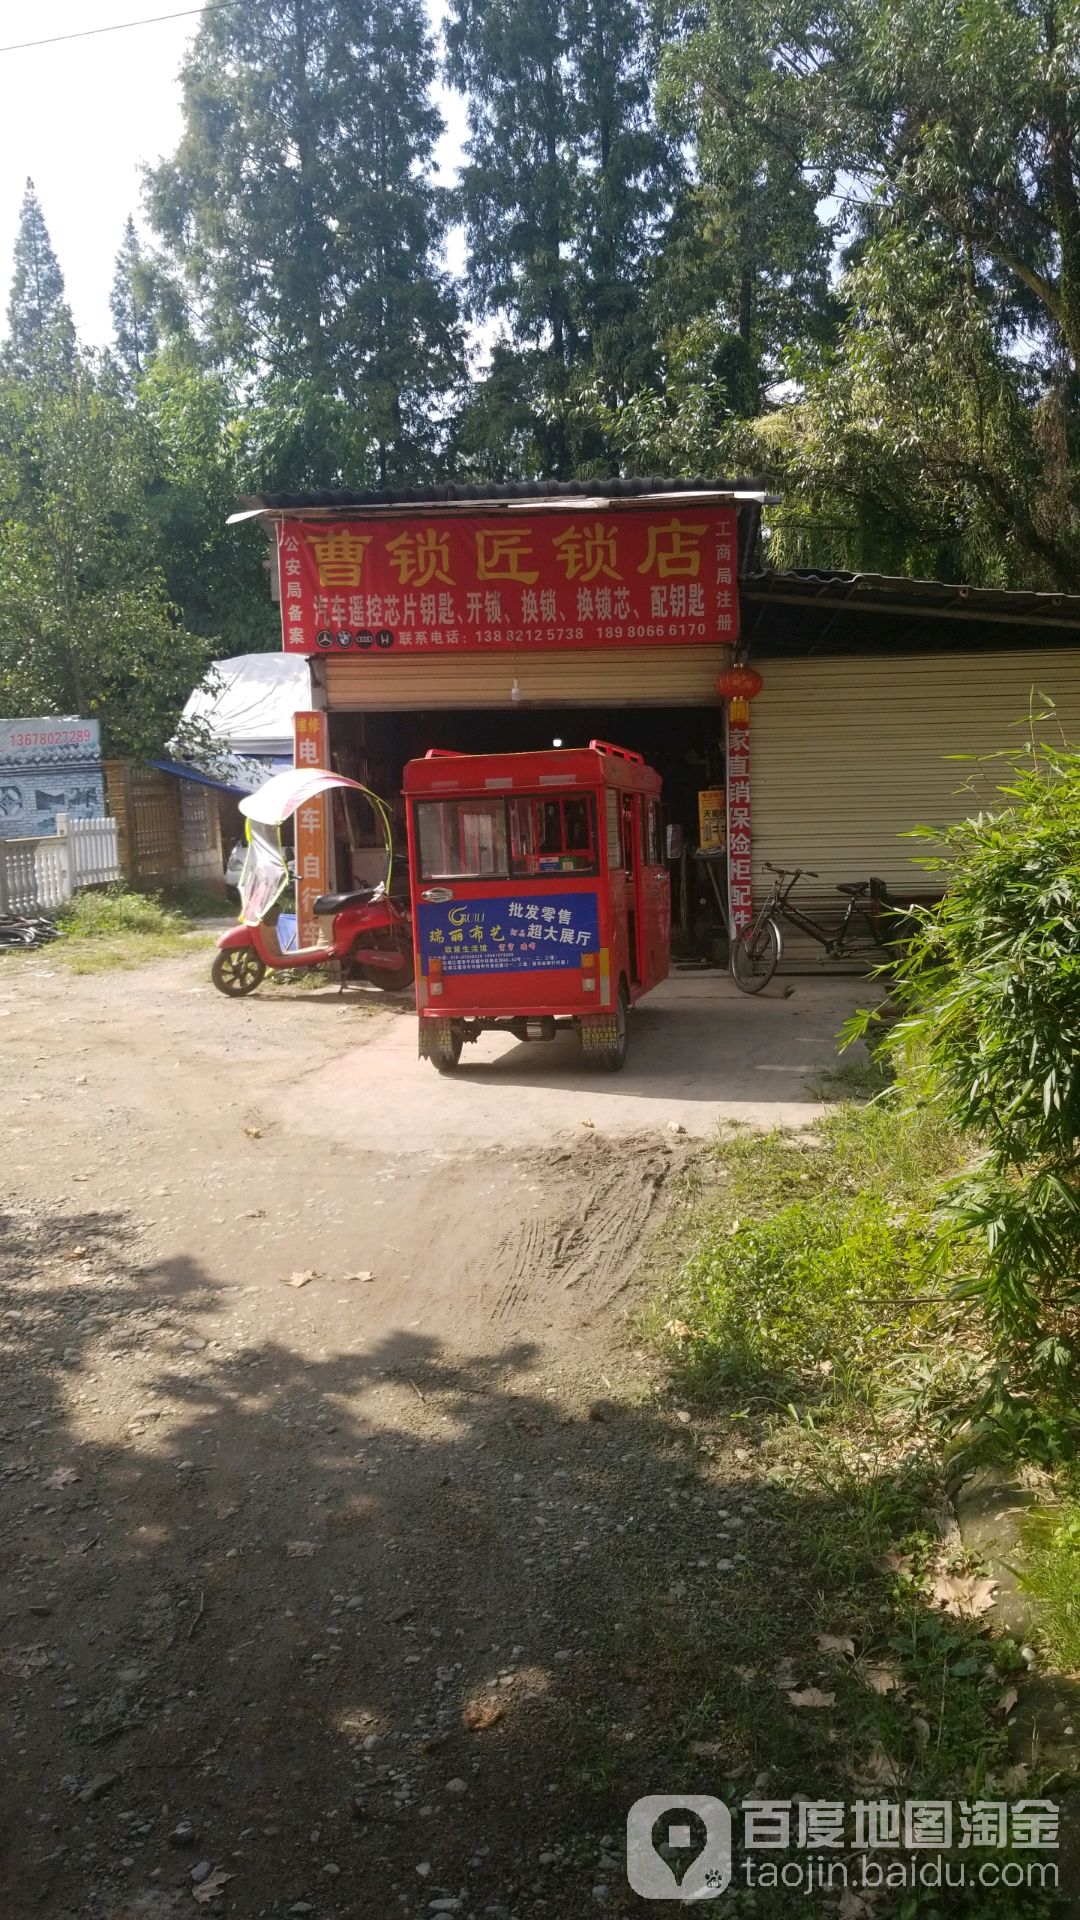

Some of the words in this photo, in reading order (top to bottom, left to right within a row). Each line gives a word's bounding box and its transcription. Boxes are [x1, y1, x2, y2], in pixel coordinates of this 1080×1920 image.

[306, 518, 709, 587] 曹锁匠锁店
[716, 521, 732, 631] 工商局注册
[285, 535, 304, 645] 公安局备案
[296, 717, 320, 733] 维修
[10, 729, 91, 746] 13678027289
[508, 901, 572, 926] 批发零售
[429, 925, 506, 944] 瑞丽布艺
[527, 923, 592, 946] 超大展厅
